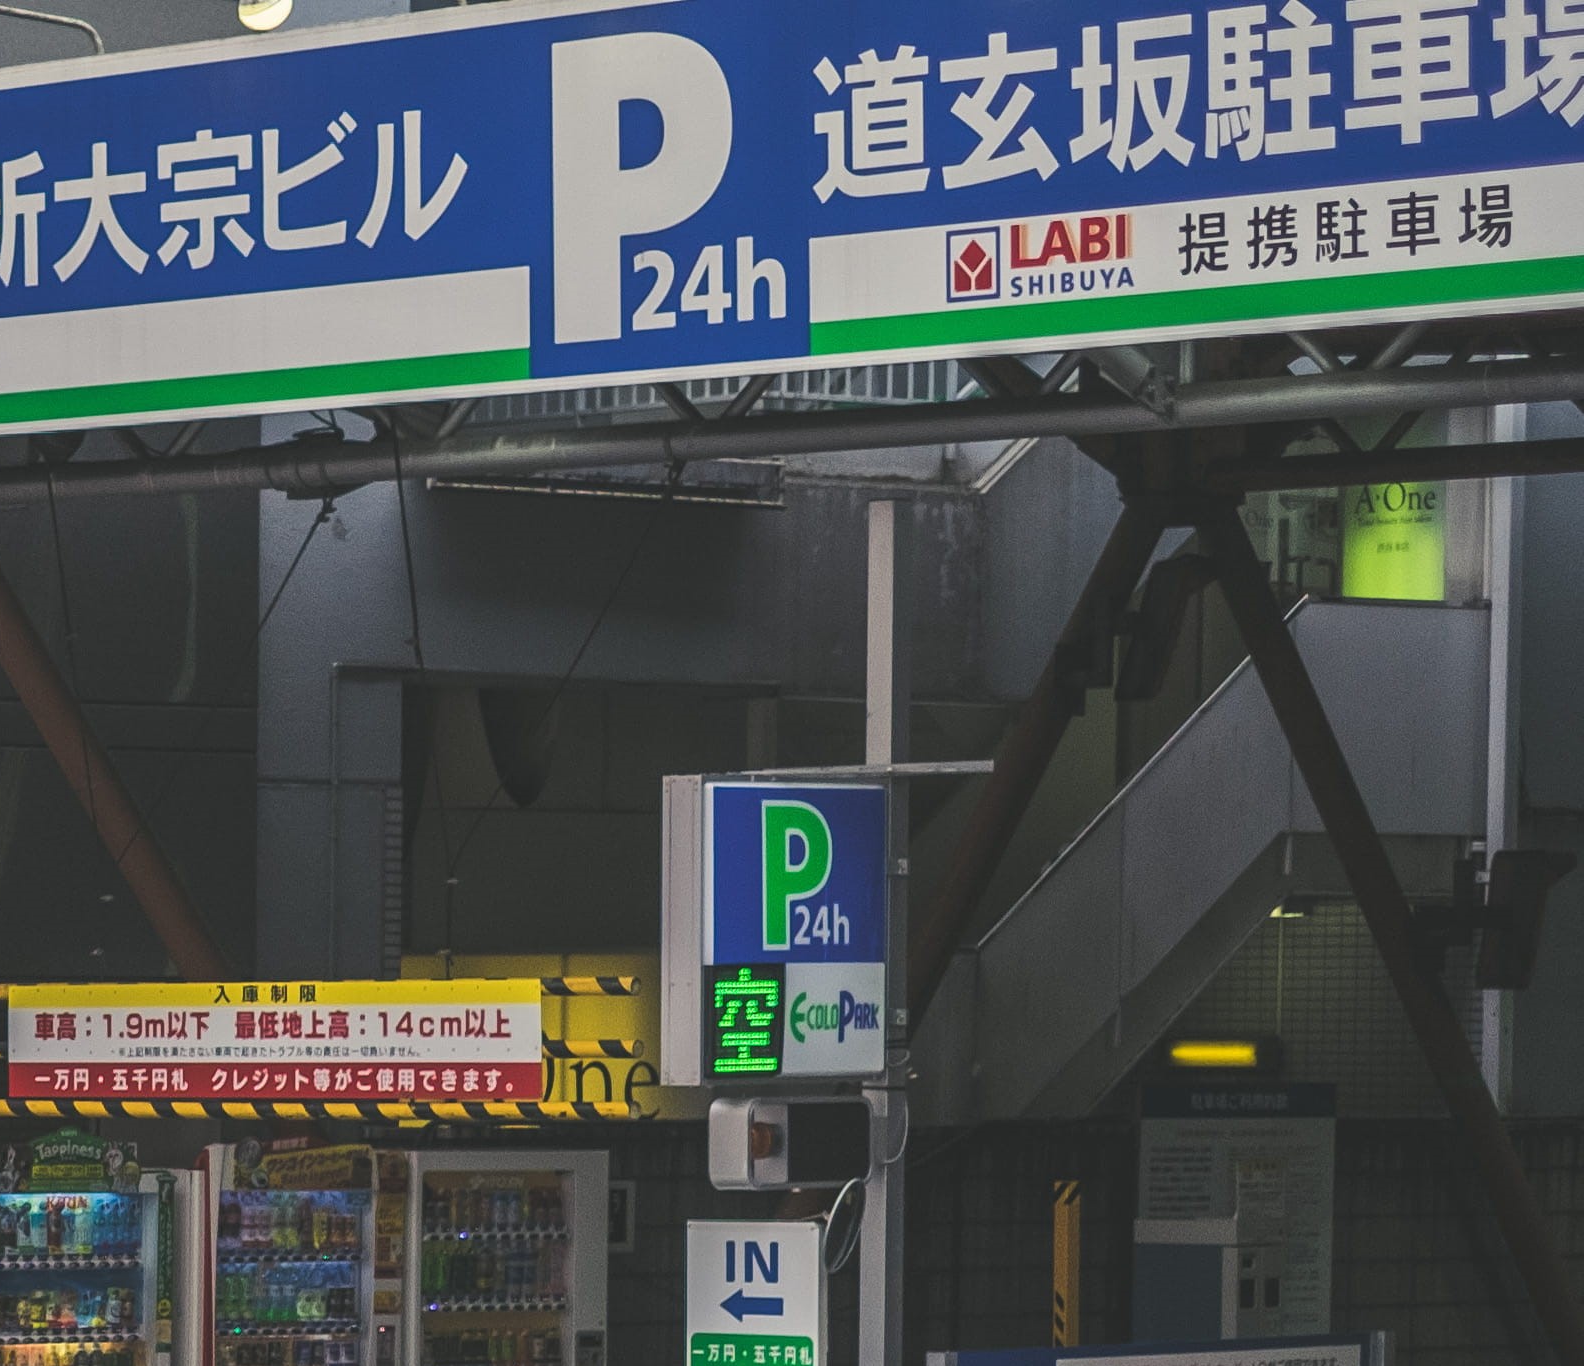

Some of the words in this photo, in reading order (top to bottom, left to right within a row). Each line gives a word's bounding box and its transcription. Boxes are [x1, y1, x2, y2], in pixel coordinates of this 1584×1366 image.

[812, 0, 1584, 205] 道玄坂駐車場
[550, 30, 733, 345] P
[1008, 213, 1133, 270] LABI
[1179, 184, 1514, 277] 提携駐車場
[632, 235, 788, 332] 24h
[1010, 265, 1136, 300] SHIBUYA
[762, 799, 834, 952] P
[794, 904, 851, 946] 24h
[213, 983, 317, 1004] 入庫制限
[713, 967, 779, 1074] 空
[35, 1068, 190, 1092] 一万円・五千円札
[543, 1058, 660, 1120] ne
[725, 1240, 780, 1284] IN
